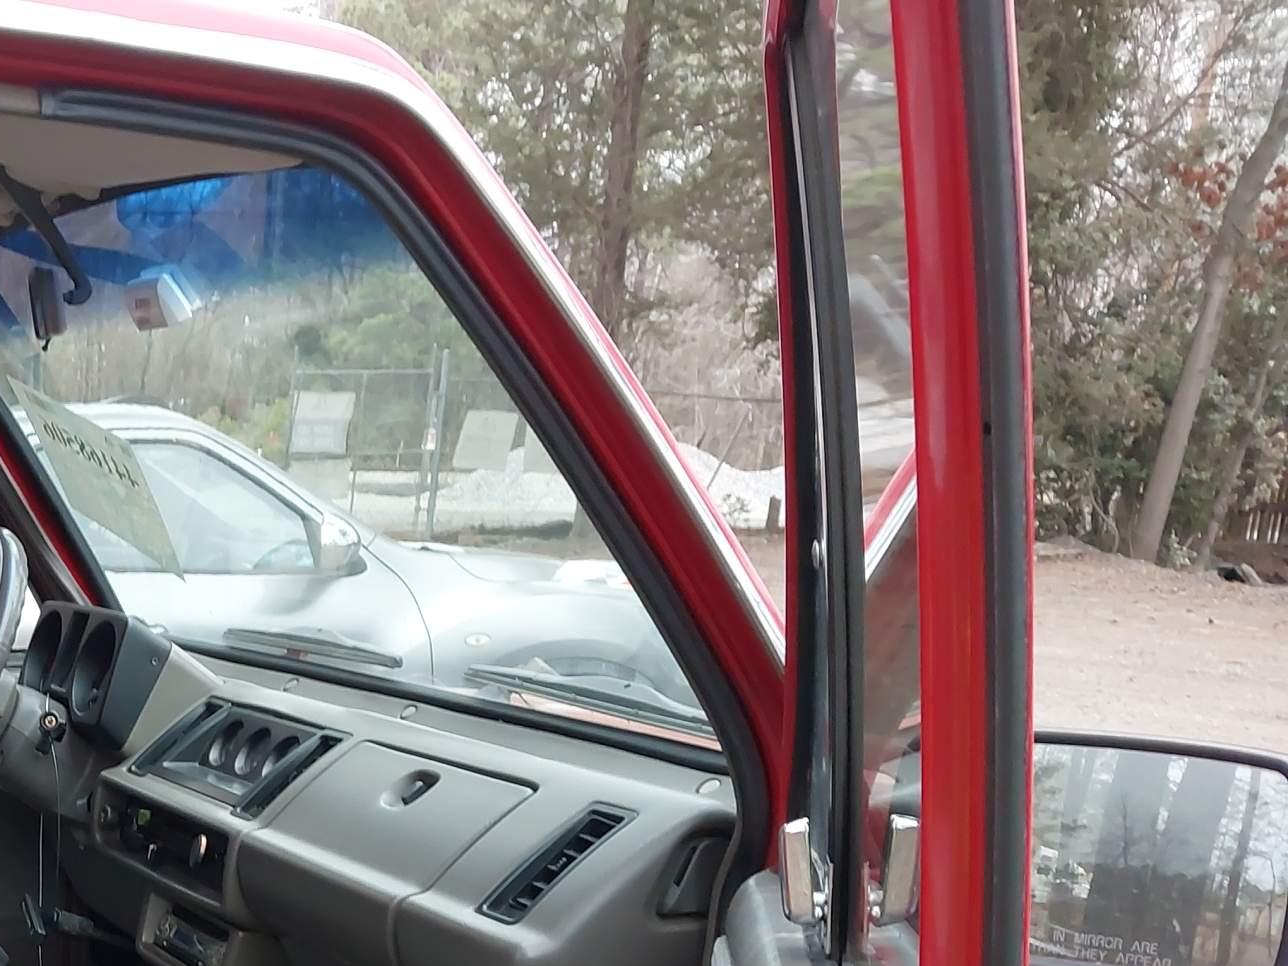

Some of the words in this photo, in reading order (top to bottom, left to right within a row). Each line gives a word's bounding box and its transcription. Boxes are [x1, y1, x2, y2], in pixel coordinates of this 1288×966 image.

[1052, 929, 1066, 942] IN
[1073, 931, 1124, 950] MIRROR
[1130, 940, 1160, 955] ARE
[1073, 945, 1108, 962] THEY
